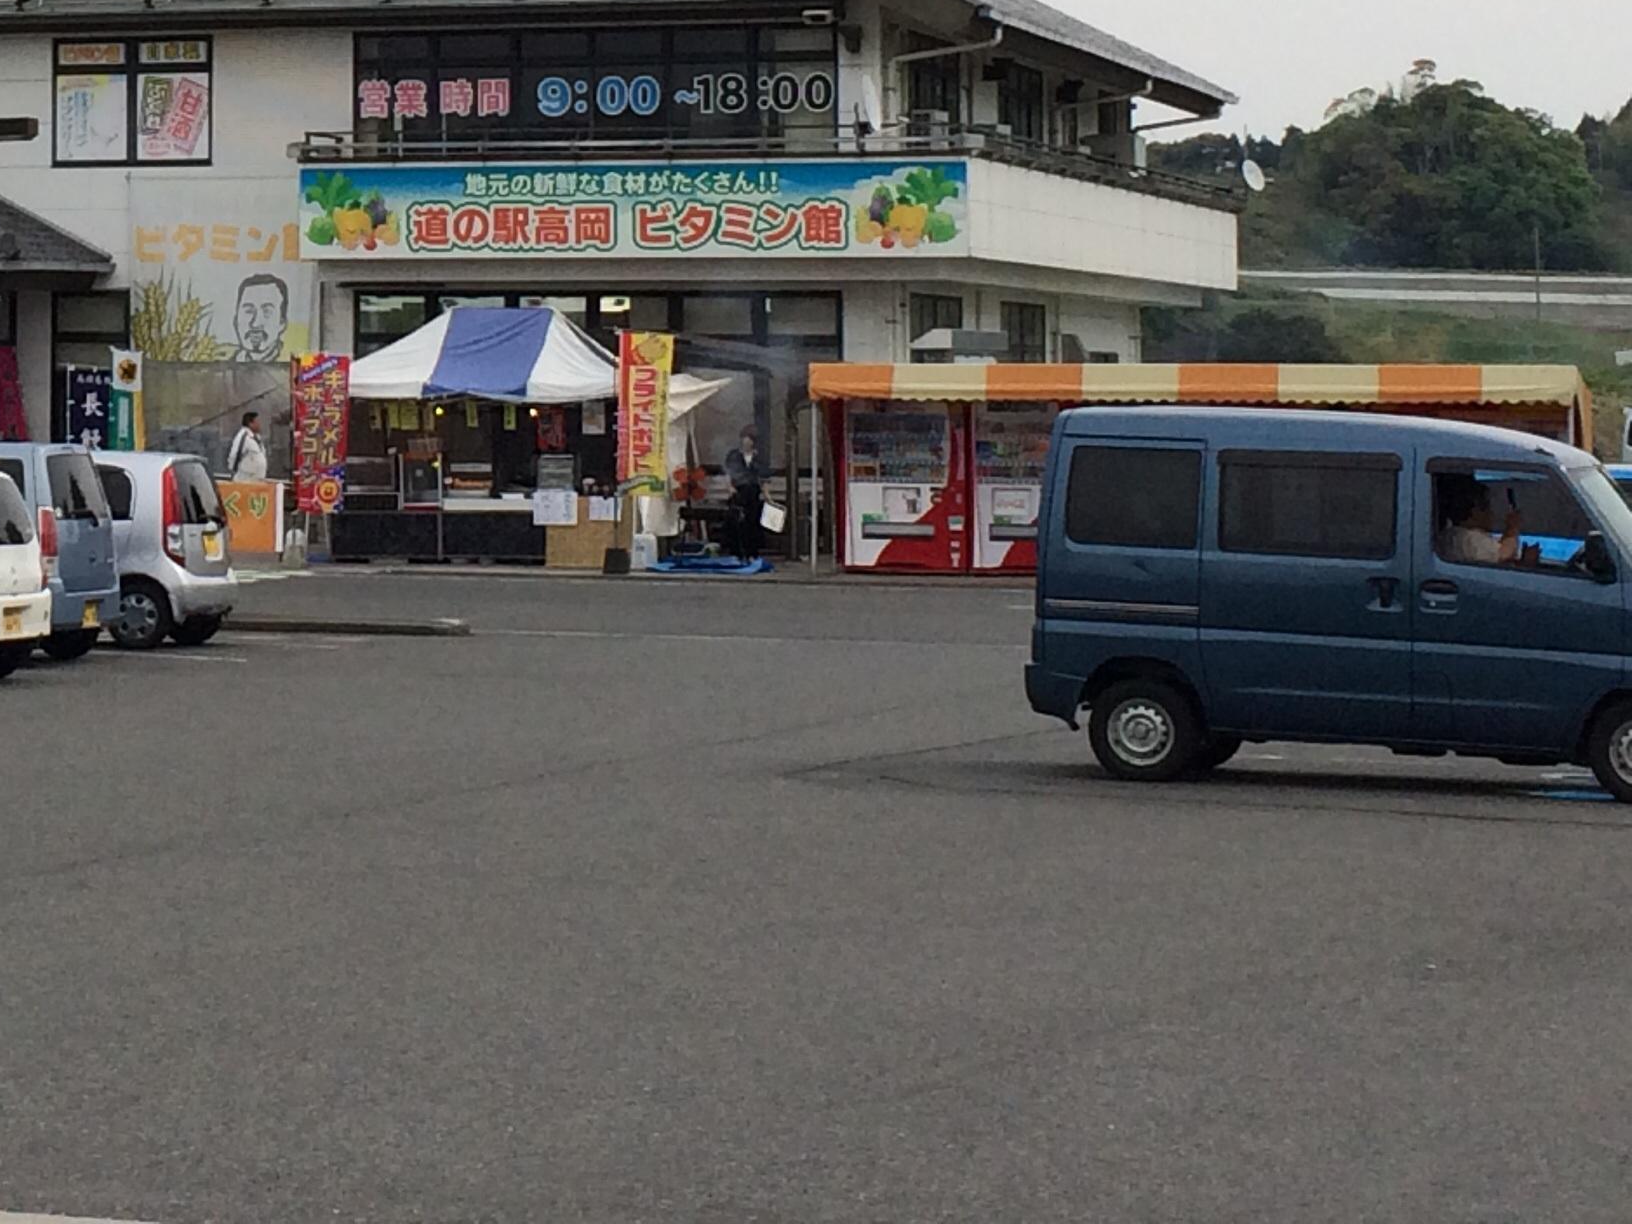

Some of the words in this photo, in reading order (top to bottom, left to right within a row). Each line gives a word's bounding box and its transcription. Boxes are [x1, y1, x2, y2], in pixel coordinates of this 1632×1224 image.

[464, 170, 780, 197] 地元の新鮮な食材がたくさん!!
[409, 203, 615, 249] 道の駅高岡
[636, 201, 846, 247] ビタミン館
[301, 384, 324, 488] ポップコーン
[319, 369, 346, 466] キャラメル
